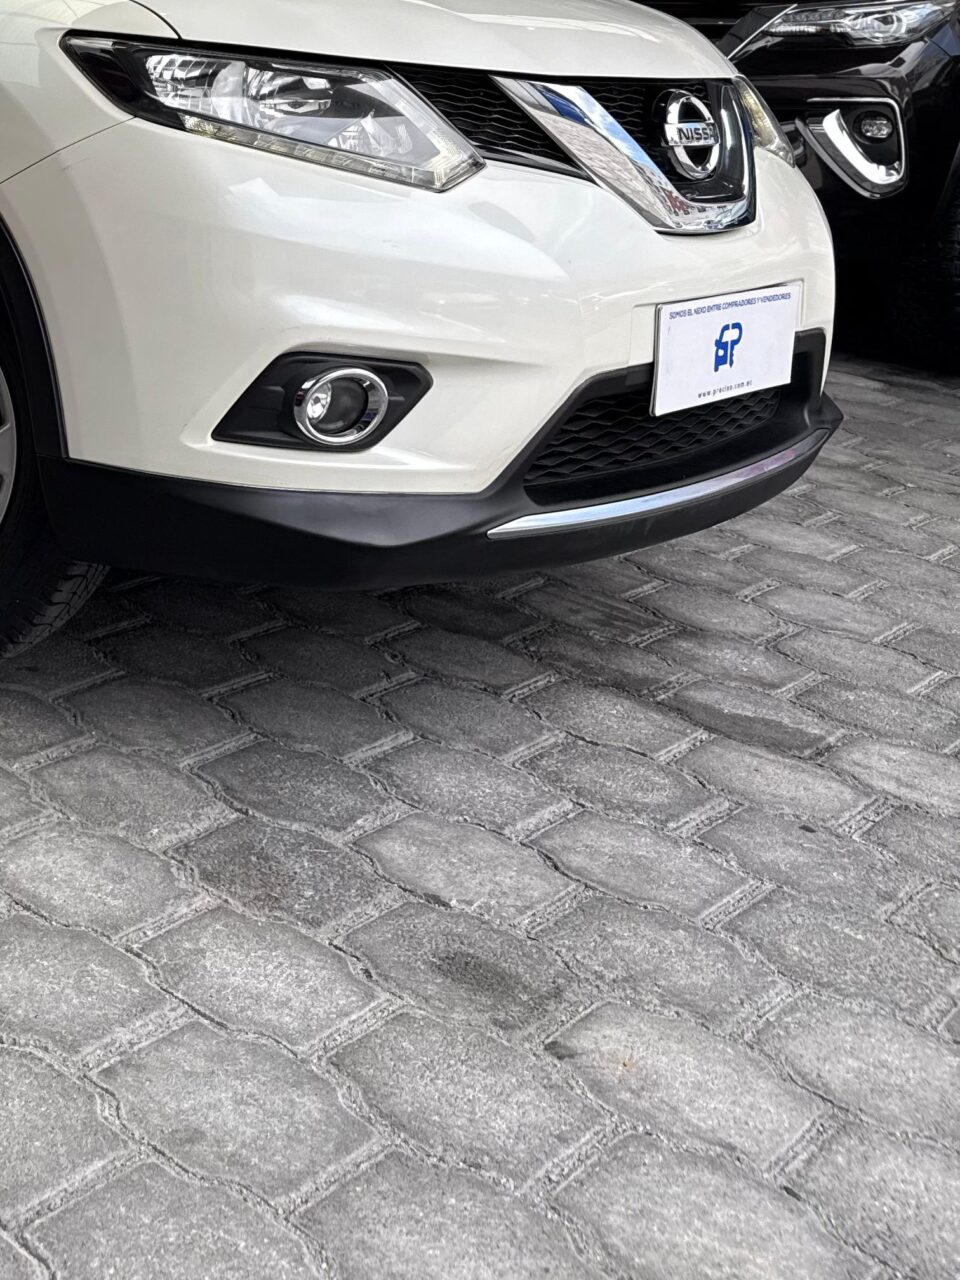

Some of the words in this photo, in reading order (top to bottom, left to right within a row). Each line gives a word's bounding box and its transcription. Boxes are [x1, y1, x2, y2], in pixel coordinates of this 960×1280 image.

[677, 126, 719, 141] NISSA
[669, 309, 686, 320] SOMOS
[693, 306, 706, 315] NEXO
[707, 303, 721, 313] ENTRE
[722, 297, 756, 310] COMPRADORES
[759, 292, 791, 304] VENDEDORES
